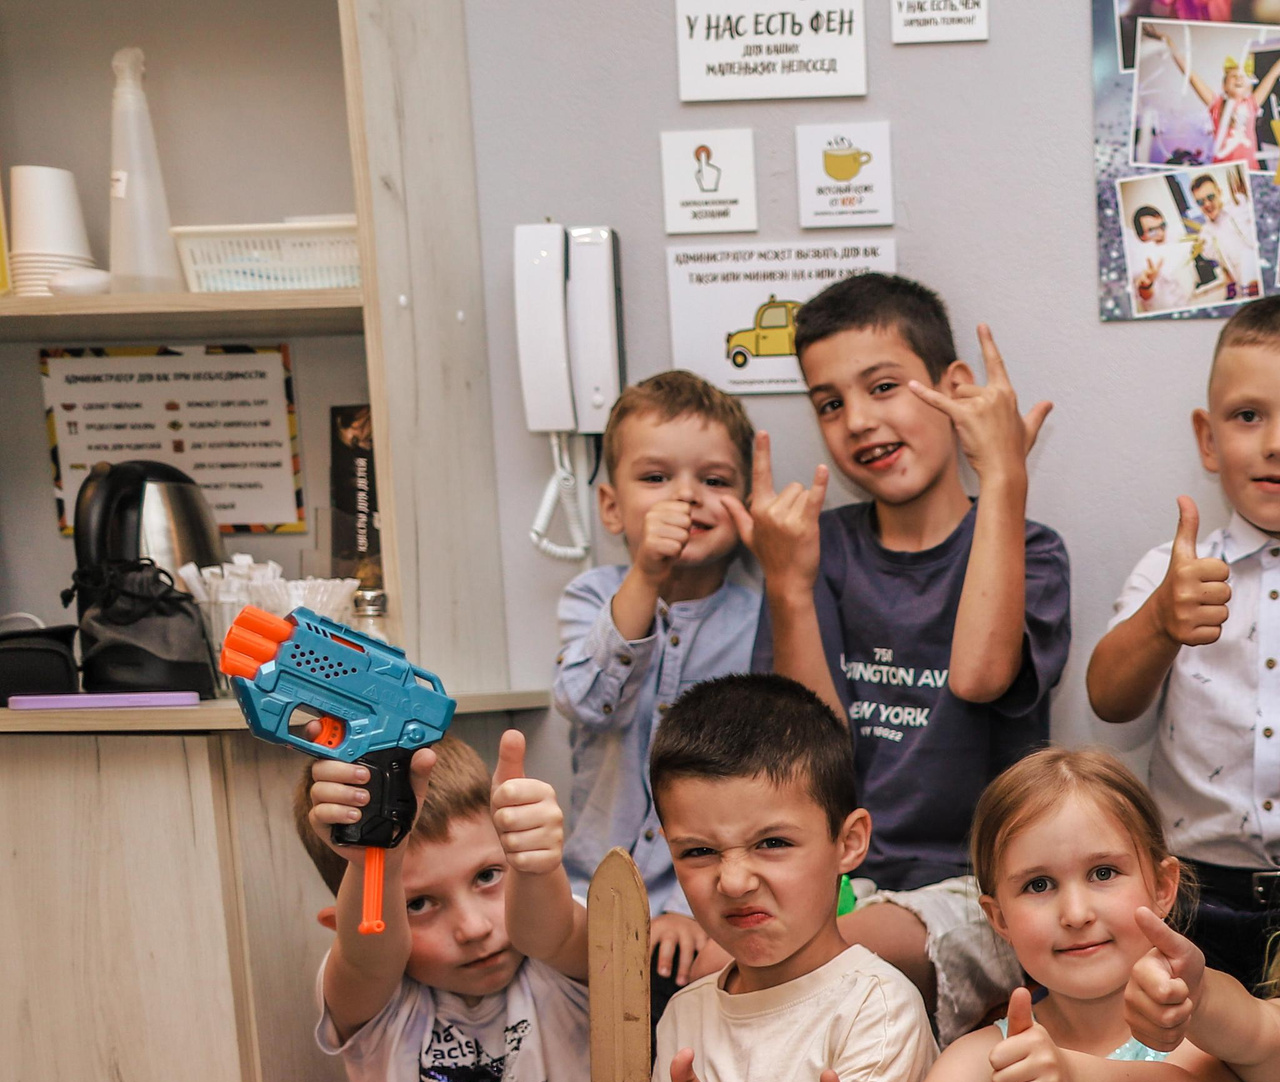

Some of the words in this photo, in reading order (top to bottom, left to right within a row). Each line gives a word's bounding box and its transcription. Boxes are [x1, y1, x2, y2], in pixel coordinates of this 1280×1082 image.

[686, 14, 699, 40] У
[705, 13, 747, 41] НАС
[753, 12, 803, 36] ЕСТЬ
[809, 9, 855, 35] ФЕН
[879, 704, 930, 727] YORK
